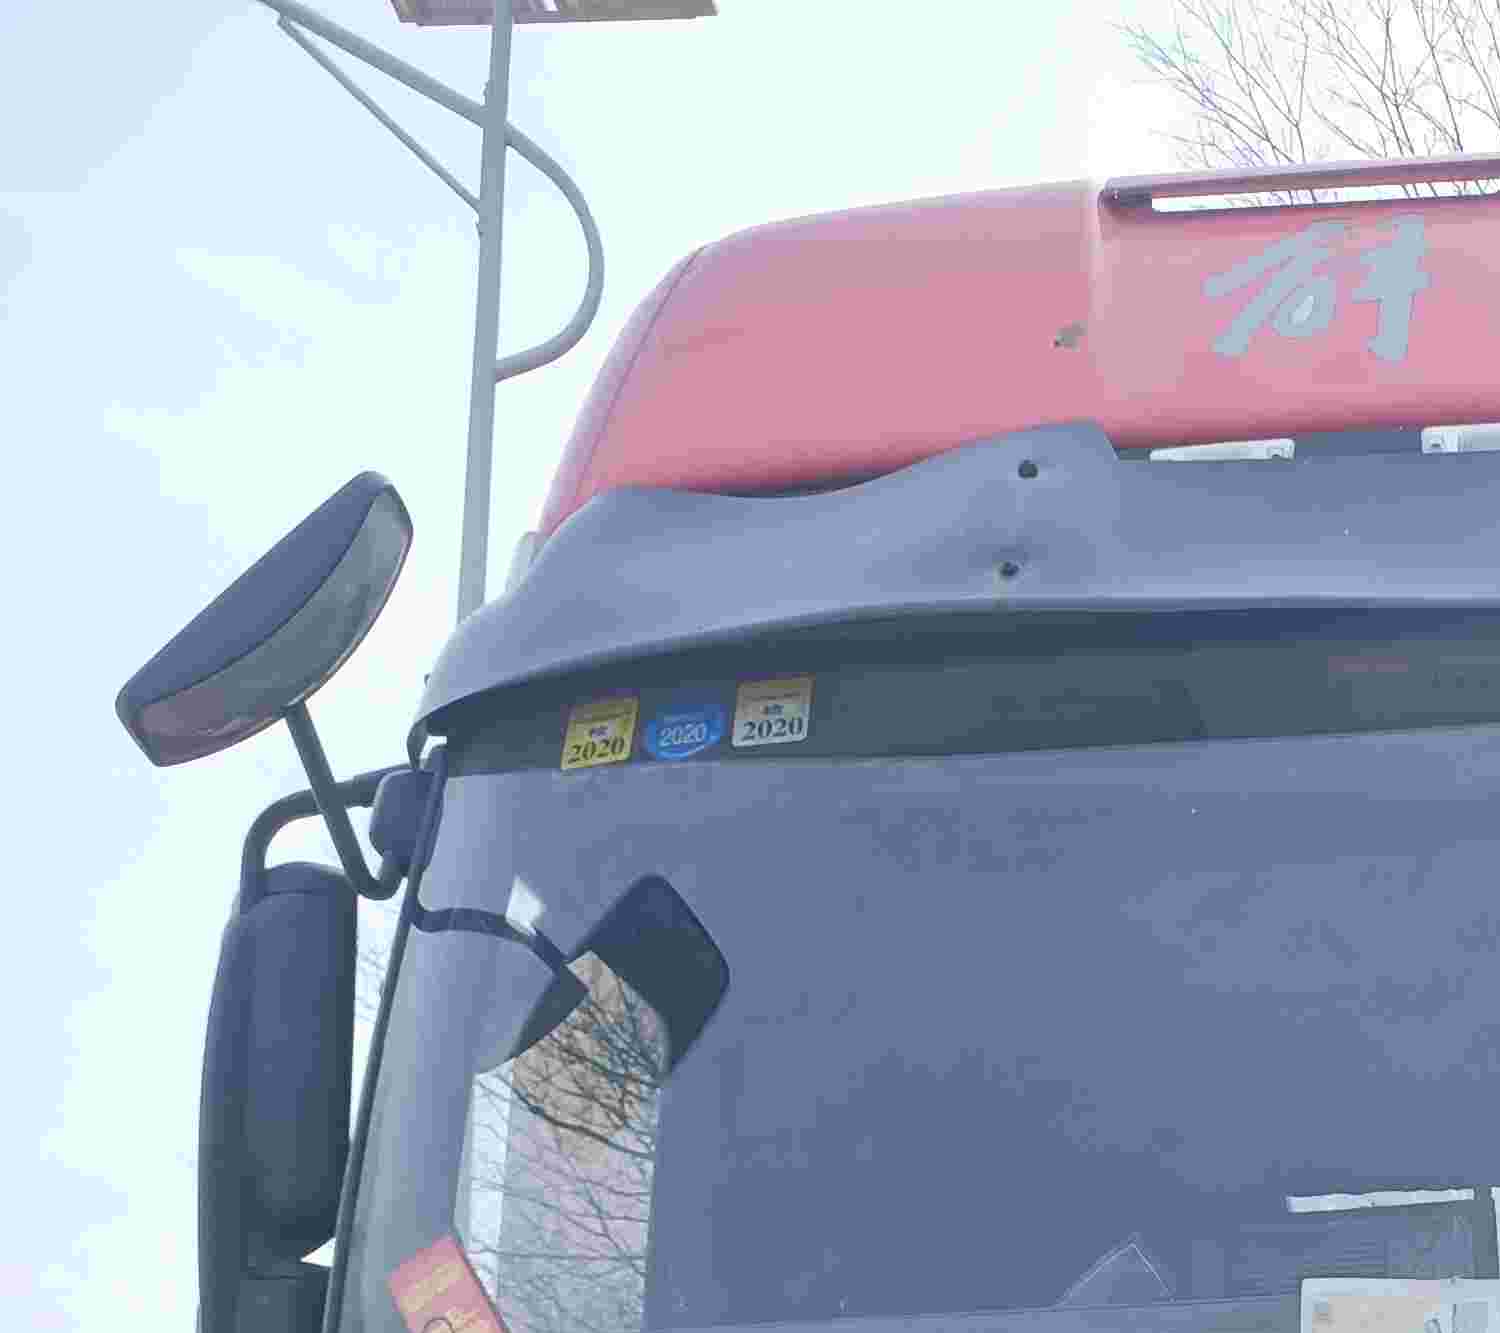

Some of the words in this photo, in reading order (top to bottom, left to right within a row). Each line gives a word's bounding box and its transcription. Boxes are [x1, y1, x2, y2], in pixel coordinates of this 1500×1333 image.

[658, 722, 706, 748] 2020
[742, 716, 803, 742] 2020
[567, 735, 625, 764] 2020
